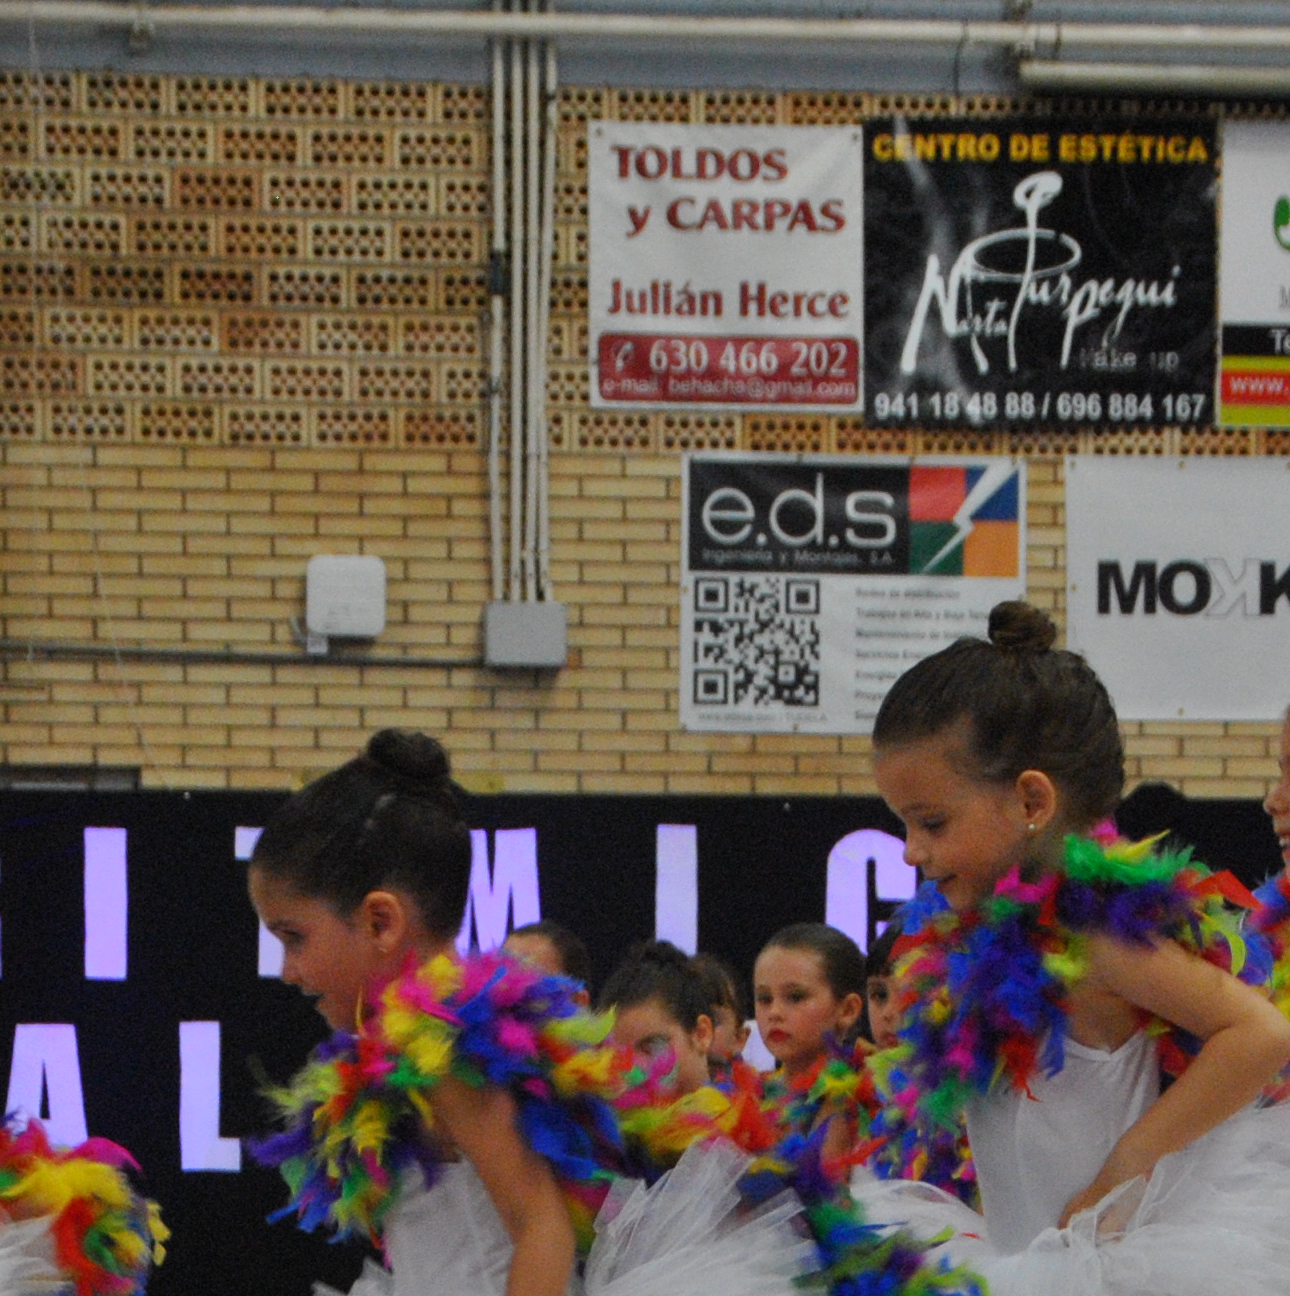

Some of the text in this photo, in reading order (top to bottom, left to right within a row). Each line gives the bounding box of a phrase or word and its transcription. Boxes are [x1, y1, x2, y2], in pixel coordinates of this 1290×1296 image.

[611, 145, 789, 182] TOLDOS
[873, 130, 1208, 163] CENTRO DE ESTÉTICA
[626, 198, 847, 238] y CARPAS
[608, 278, 850, 318] Julián Herce
[649, 340, 847, 378] 630 466 202
[874, 391, 1206, 421] 941 18 48 88 / 696 884 167
[701, 471, 897, 549] e.d.s
